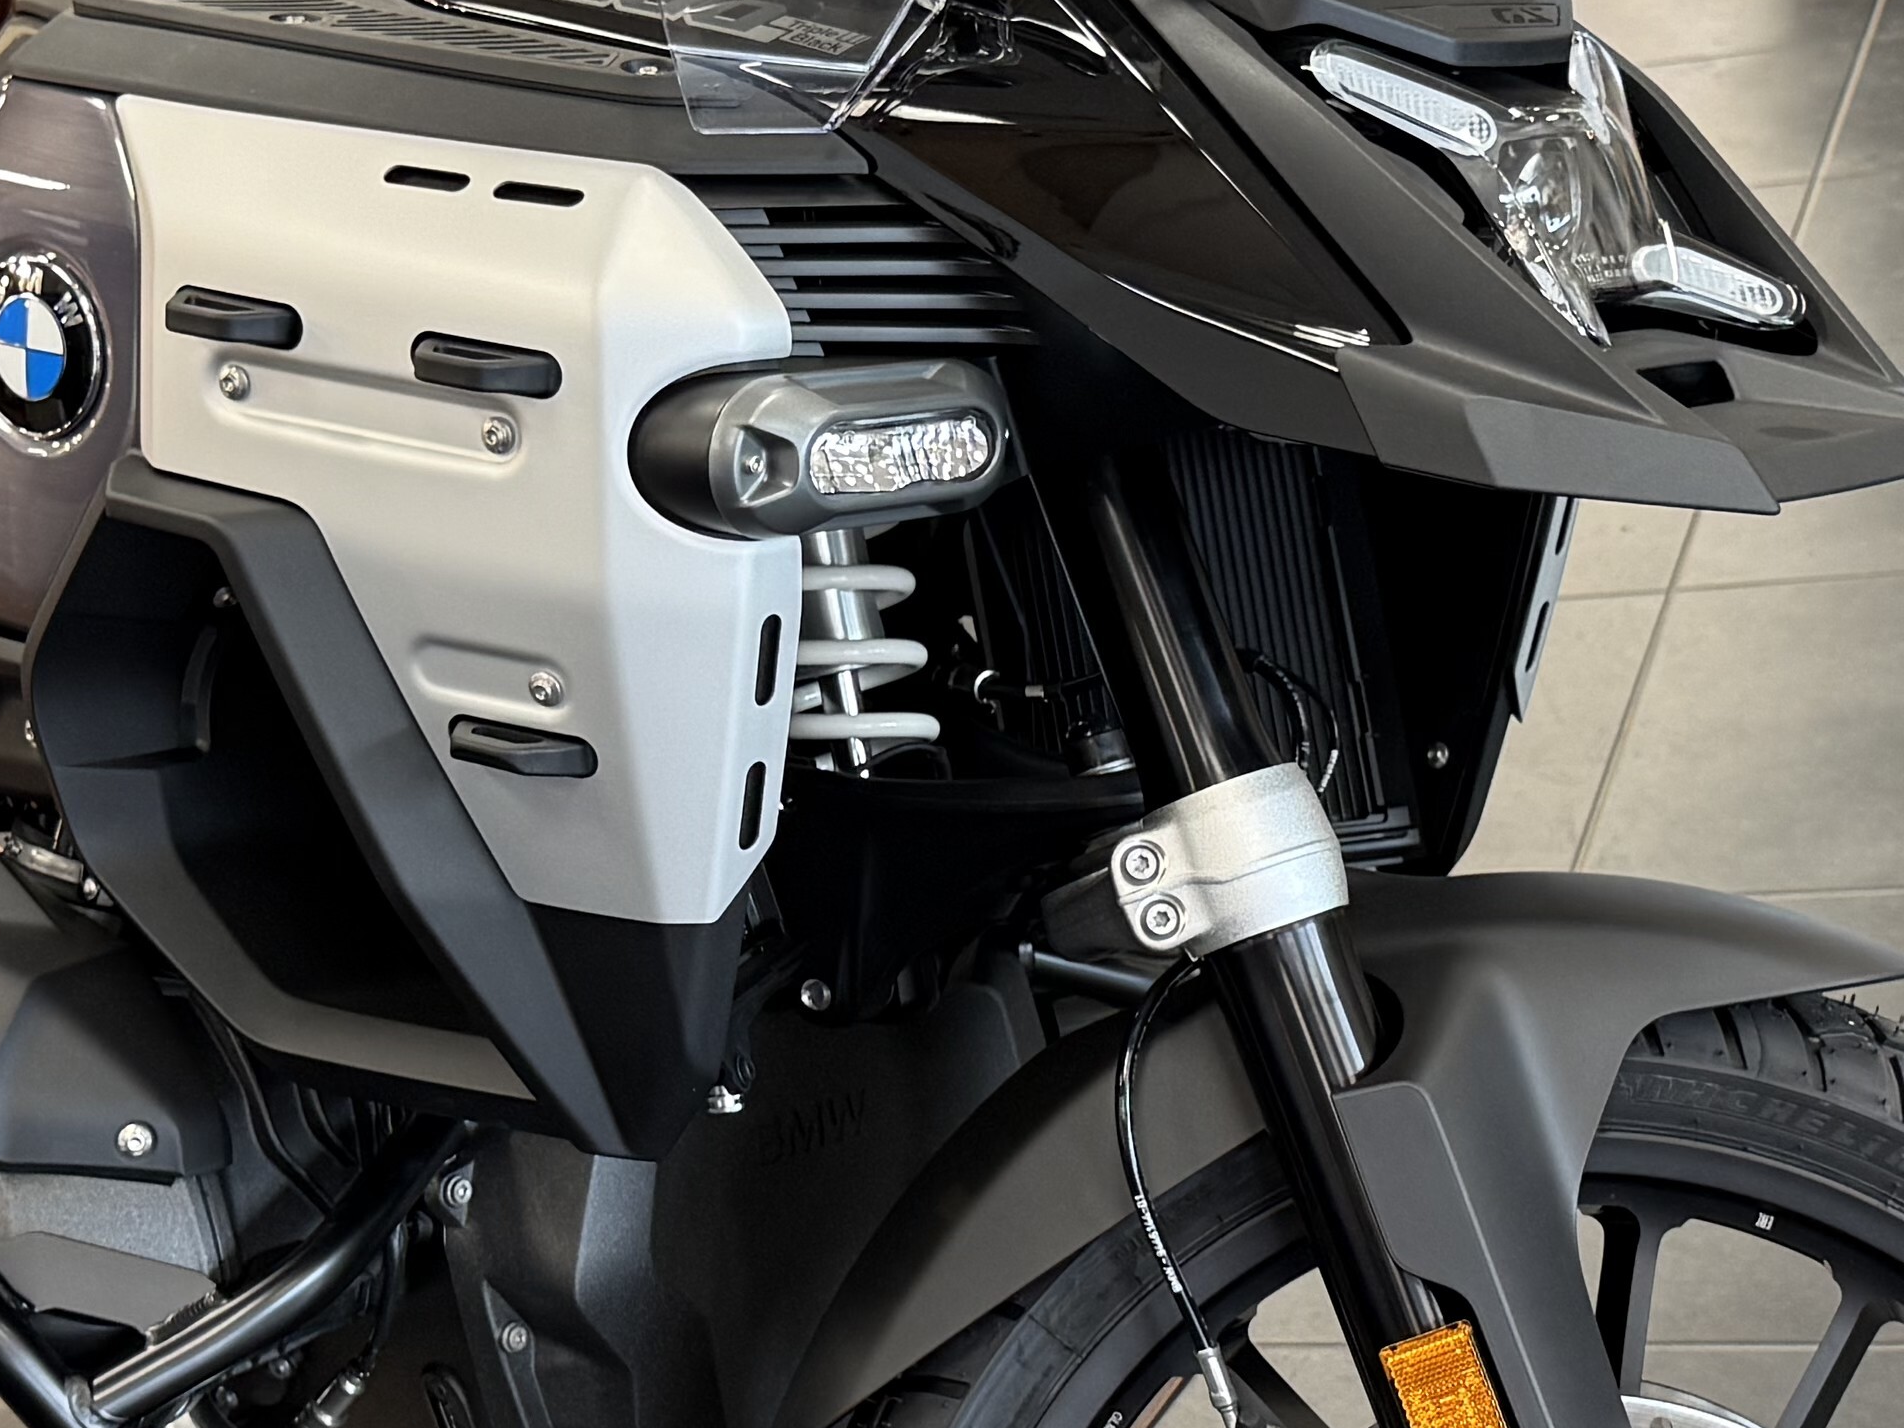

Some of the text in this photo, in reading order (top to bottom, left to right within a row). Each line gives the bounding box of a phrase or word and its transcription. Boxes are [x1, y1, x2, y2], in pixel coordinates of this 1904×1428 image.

[787, 18, 840, 40] Triple
[789, 31, 844, 55] Black
[755, 1087, 866, 1167] BMW
